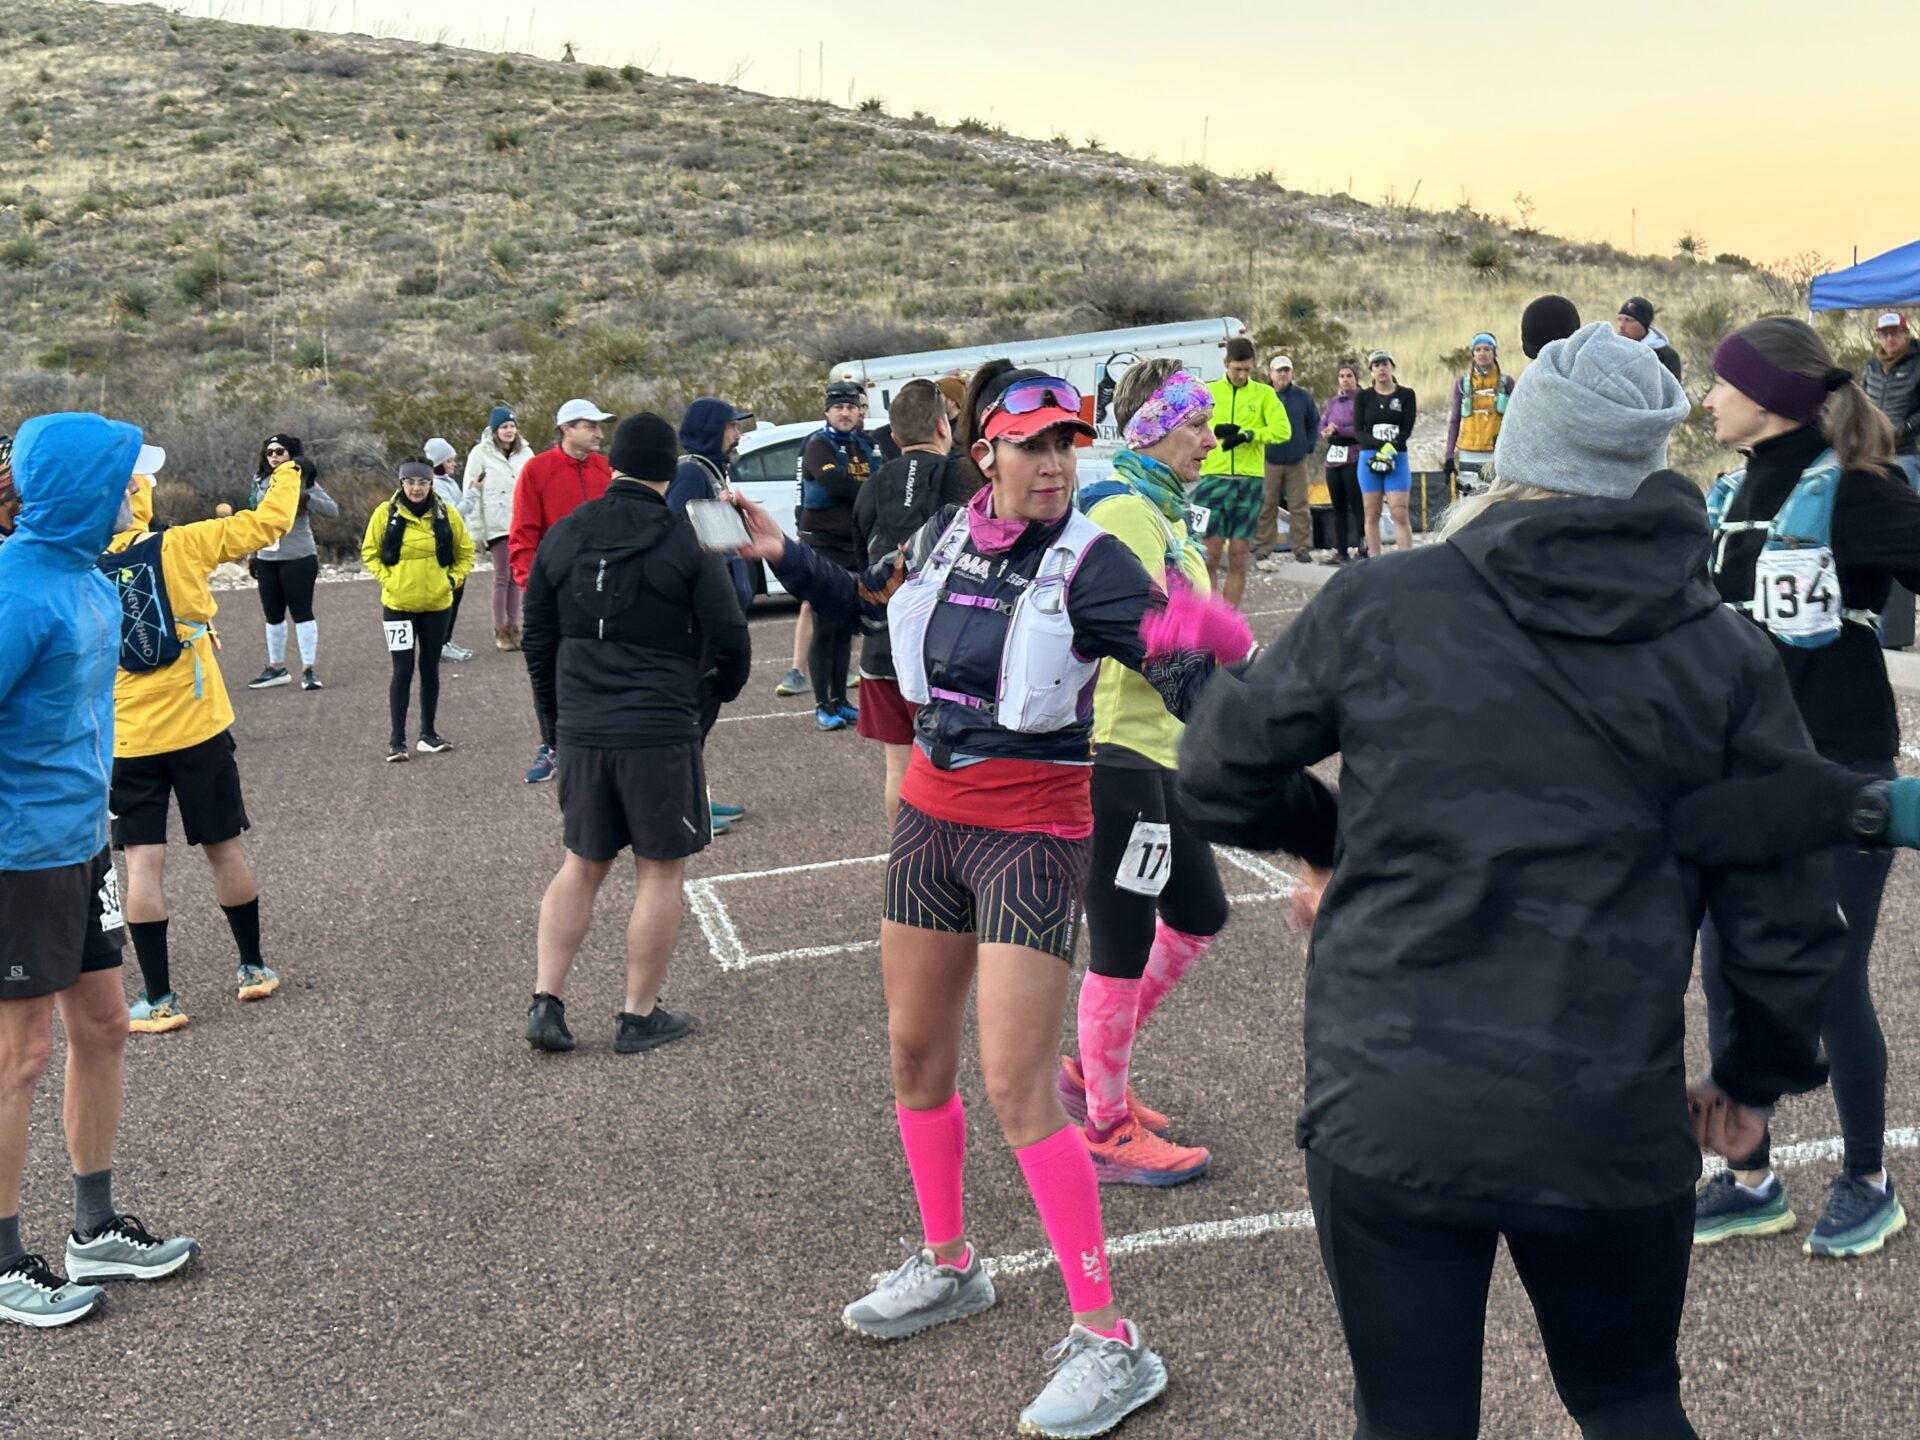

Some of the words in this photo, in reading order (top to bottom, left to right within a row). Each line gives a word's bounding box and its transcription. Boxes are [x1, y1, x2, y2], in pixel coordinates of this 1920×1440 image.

[903, 459, 918, 507] SALOMON
[1762, 570, 1832, 619] 134
[1136, 842, 1169, 880] 17
